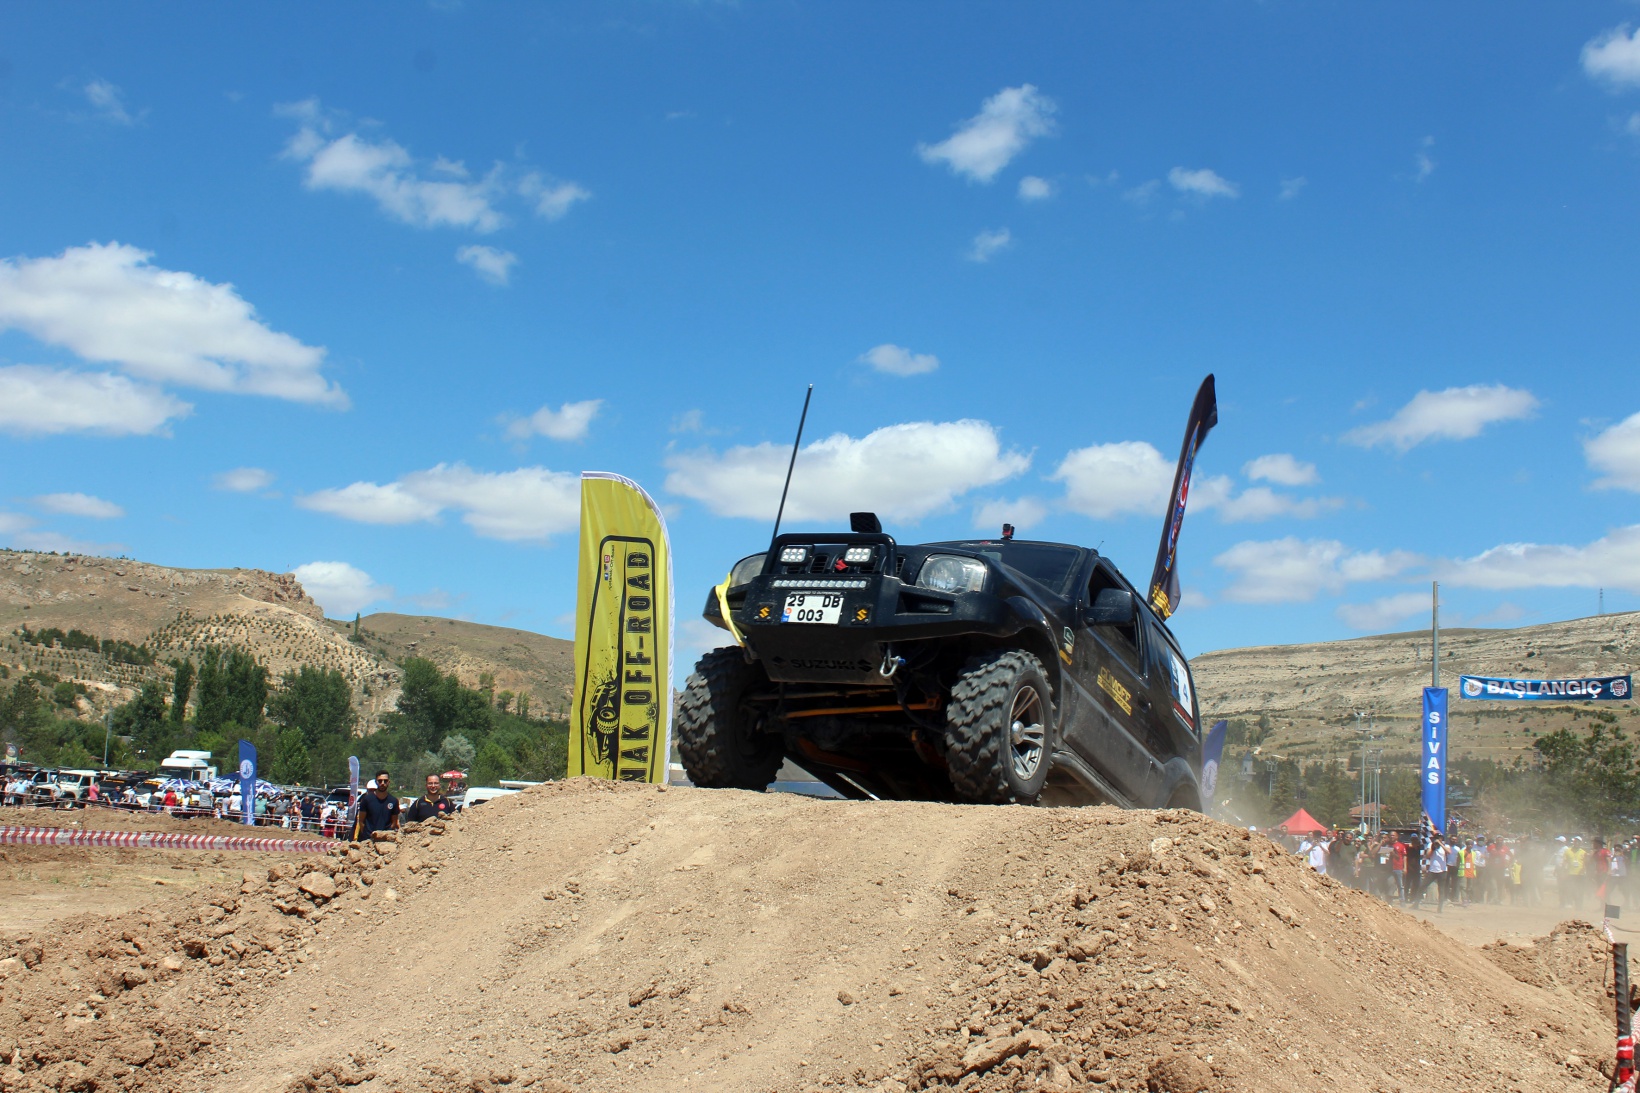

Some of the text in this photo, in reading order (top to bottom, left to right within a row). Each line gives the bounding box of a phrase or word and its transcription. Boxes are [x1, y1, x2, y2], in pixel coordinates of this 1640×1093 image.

[787, 595, 840, 608] 29 DB
[797, 609, 824, 621] 003
[624, 551, 652, 706] OFF-ROAD
[790, 659, 856, 670] SUZUKI
[1487, 680, 1603, 699] BAŞLANGIÇ
